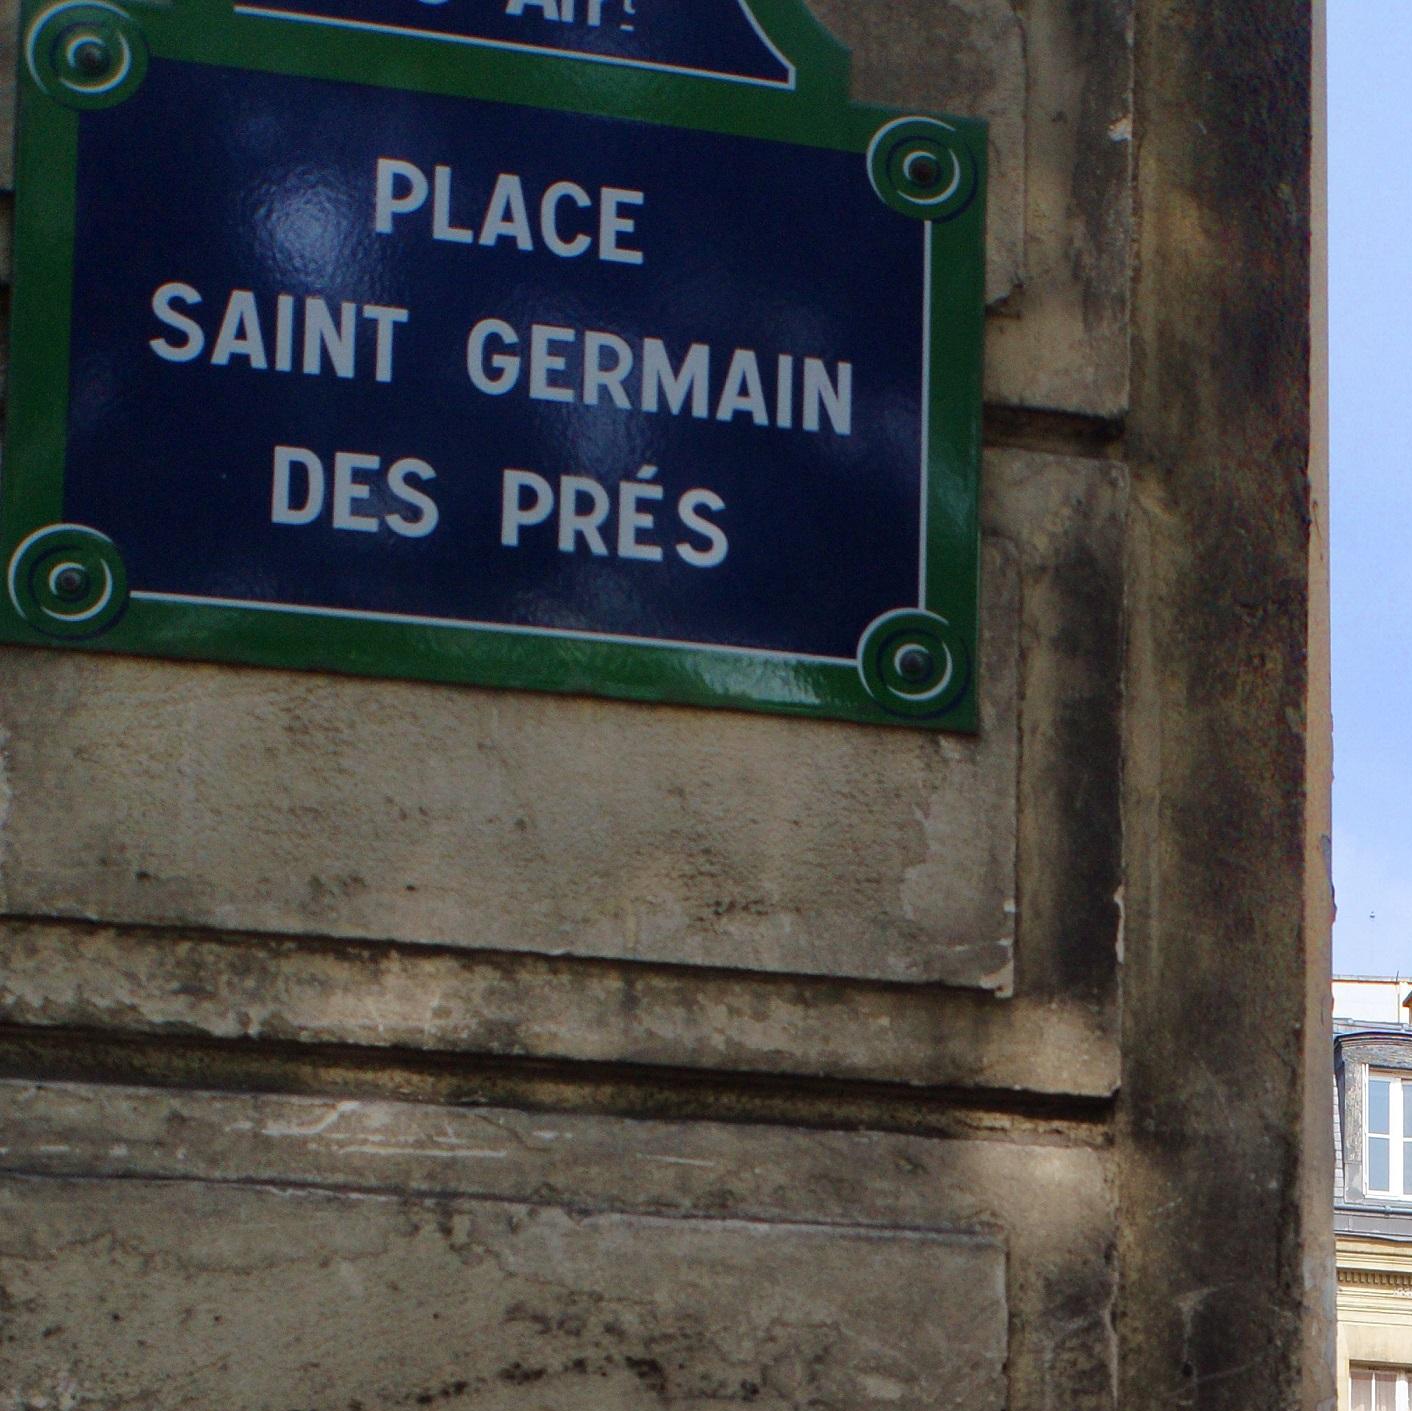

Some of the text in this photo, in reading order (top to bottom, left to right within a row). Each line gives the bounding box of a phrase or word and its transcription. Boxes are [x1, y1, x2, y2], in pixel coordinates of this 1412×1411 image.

[374, 157, 645, 265] PLACE
[149, 282, 854, 436] SAINT GERMAIN
[270, 445, 729, 568] DES PRÉS
